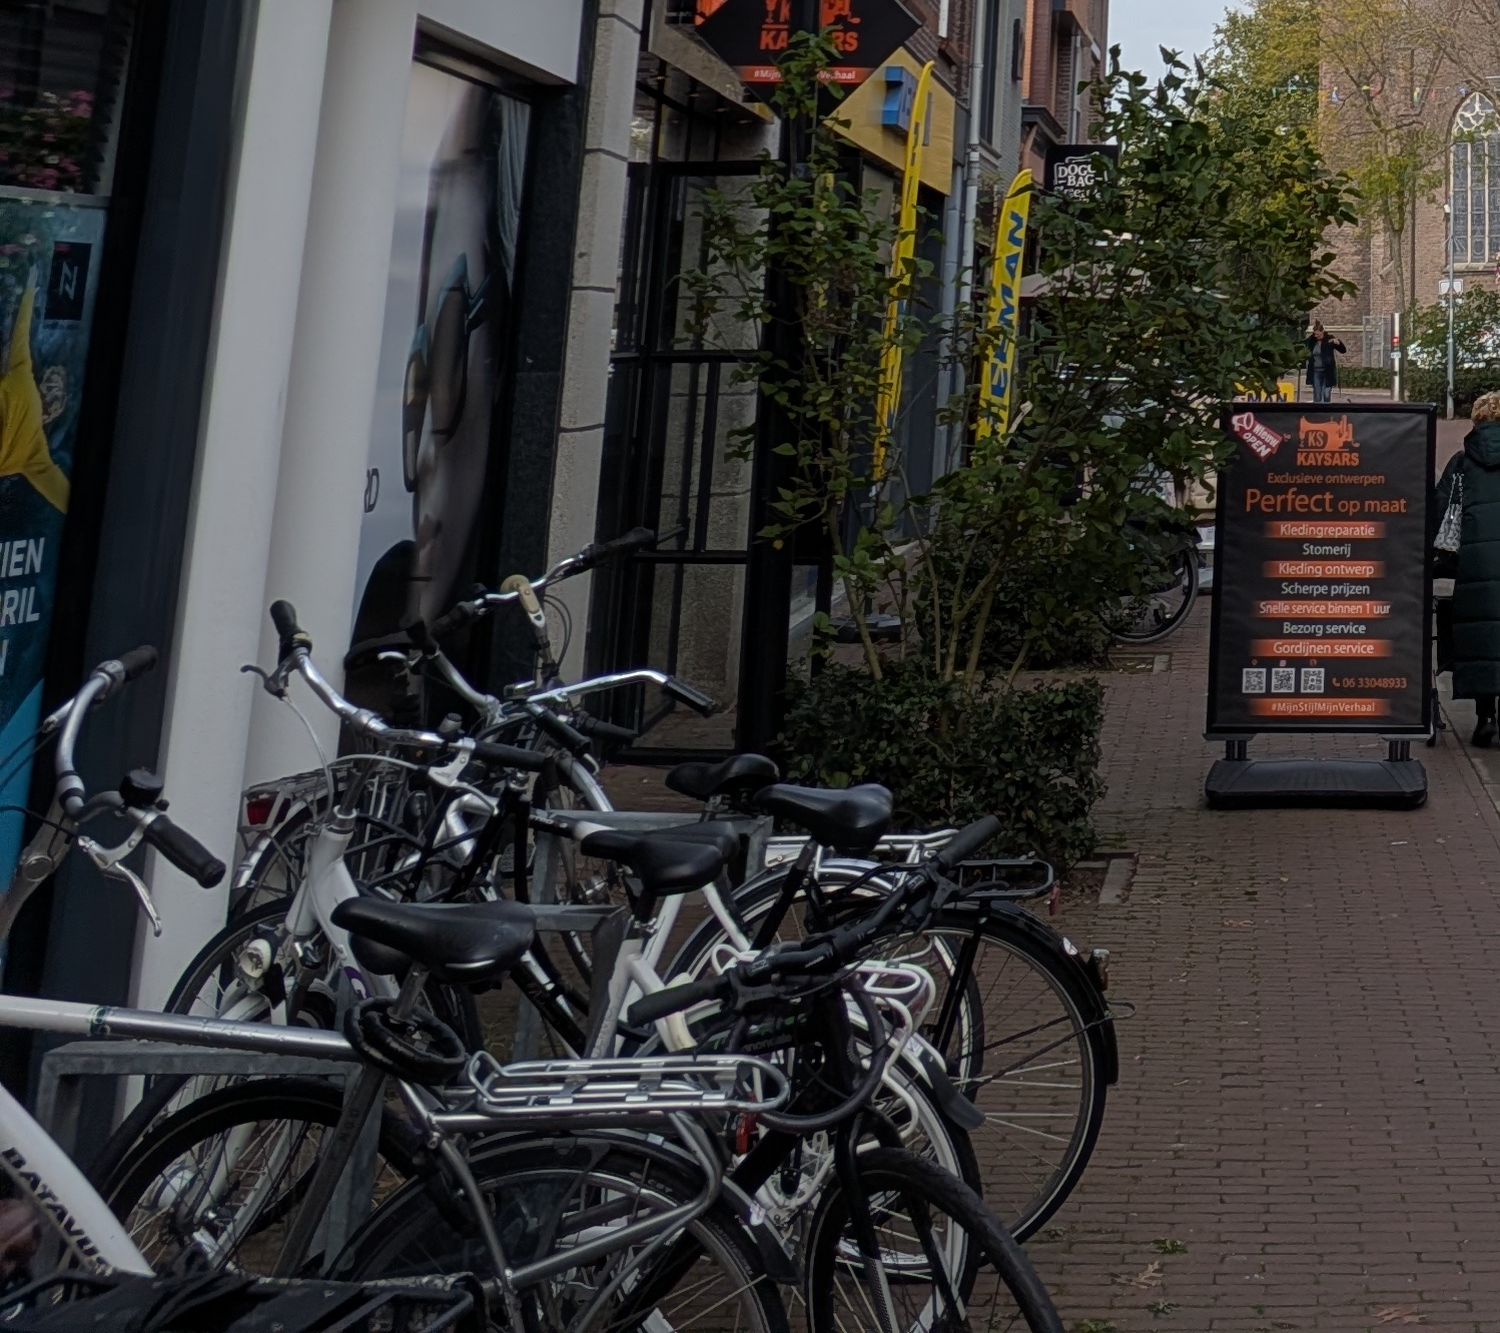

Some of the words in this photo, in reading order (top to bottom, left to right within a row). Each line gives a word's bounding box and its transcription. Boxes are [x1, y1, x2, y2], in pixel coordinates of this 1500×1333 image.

[760, 31, 859, 51] KARS
[1067, 174, 1095, 187] BAG
[1242, 431, 1272, 458] OPEN
[1307, 431, 1324, 447] KS
[1297, 452, 1360, 466] KAYSARS
[1267, 473, 1323, 484] Exclusieve
[1326, 474, 1385, 486] ontwerpen
[1246, 487, 1334, 513] Perfect
[1338, 499, 1361, 515] op
[1364, 498, 1407, 513] maat
[1280, 524, 1375, 538] Kledingreparatie
[1302, 543, 1351, 557] Stomerij
[0, 537, 46, 578] IEN
[1278, 563, 1323, 577] Kleding
[1325, 564, 1375, 577] ontwerp
[1281, 582, 1328, 596] Scherpe
[1330, 583, 1371, 597] prijzen
[1259, 602, 1290, 614] Snelle
[1291, 602, 1327, 614] service
[1328, 602, 1363, 614] binnen
[1365, 602, 1370, 614] 1
[1373, 603, 1391, 614] uur
[1283, 622, 1323, 636] Bezorg
[1325, 622, 1367, 634] service
[1273, 642, 1332, 656] Gordijnen
[1333, 643, 1375, 654] service
[1342, 677, 1355, 688] 06
[1271, 702, 1375, 714] #MijnStijlMijnVerhaal
